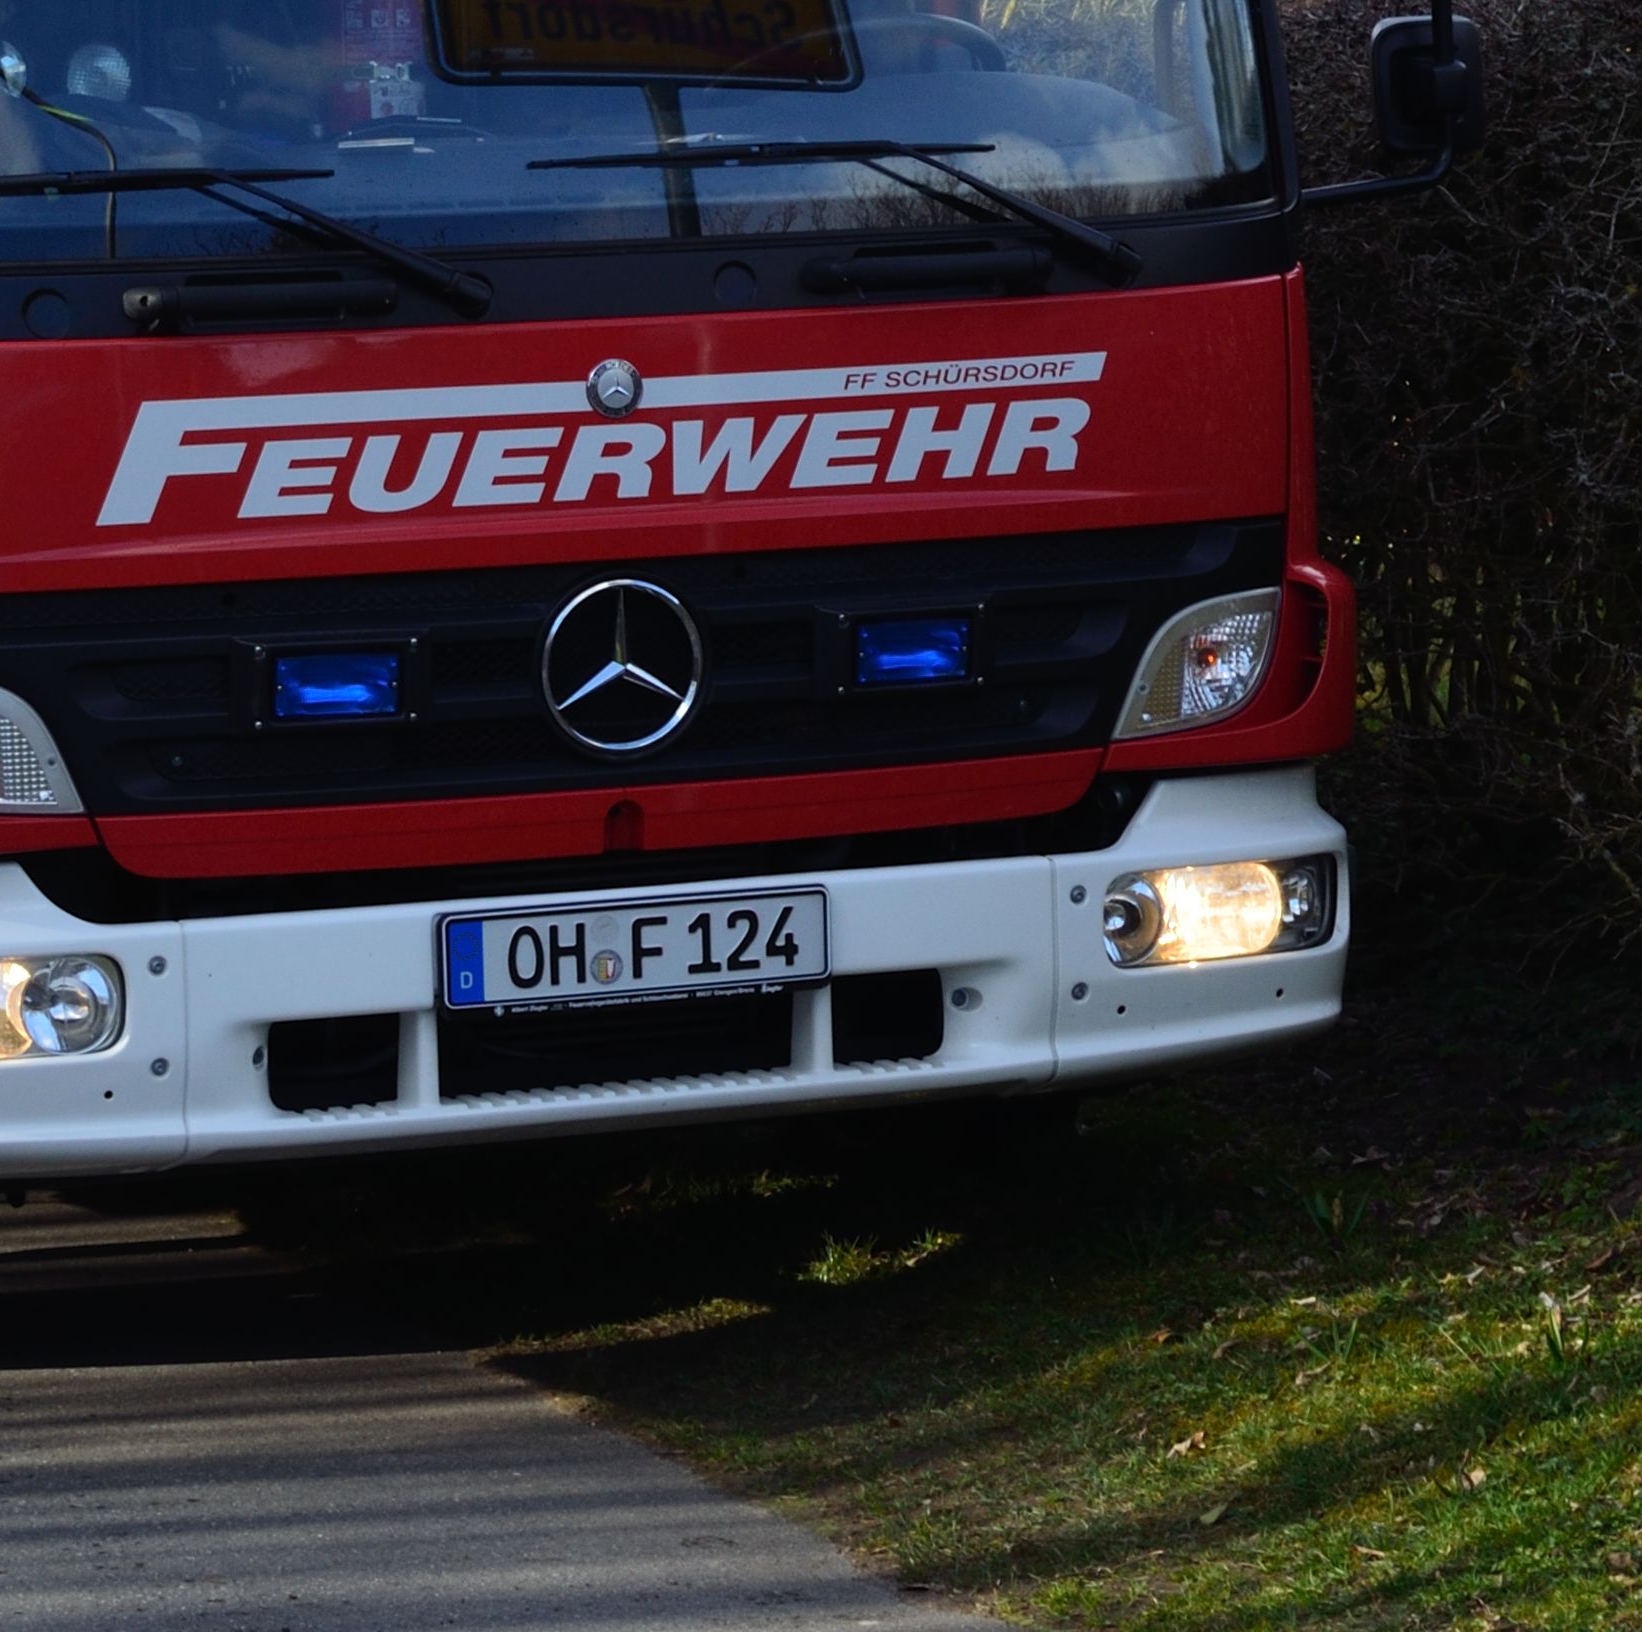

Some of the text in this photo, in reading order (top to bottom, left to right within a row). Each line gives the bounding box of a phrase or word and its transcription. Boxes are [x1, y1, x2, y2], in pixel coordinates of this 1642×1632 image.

[843, 361, 1075, 390] FF SCHÜRSDORF
[95, 353, 1107, 528] FEUERWEHR
[508, 906, 799, 989] OH F 124
[460, 971, 473, 989] D
